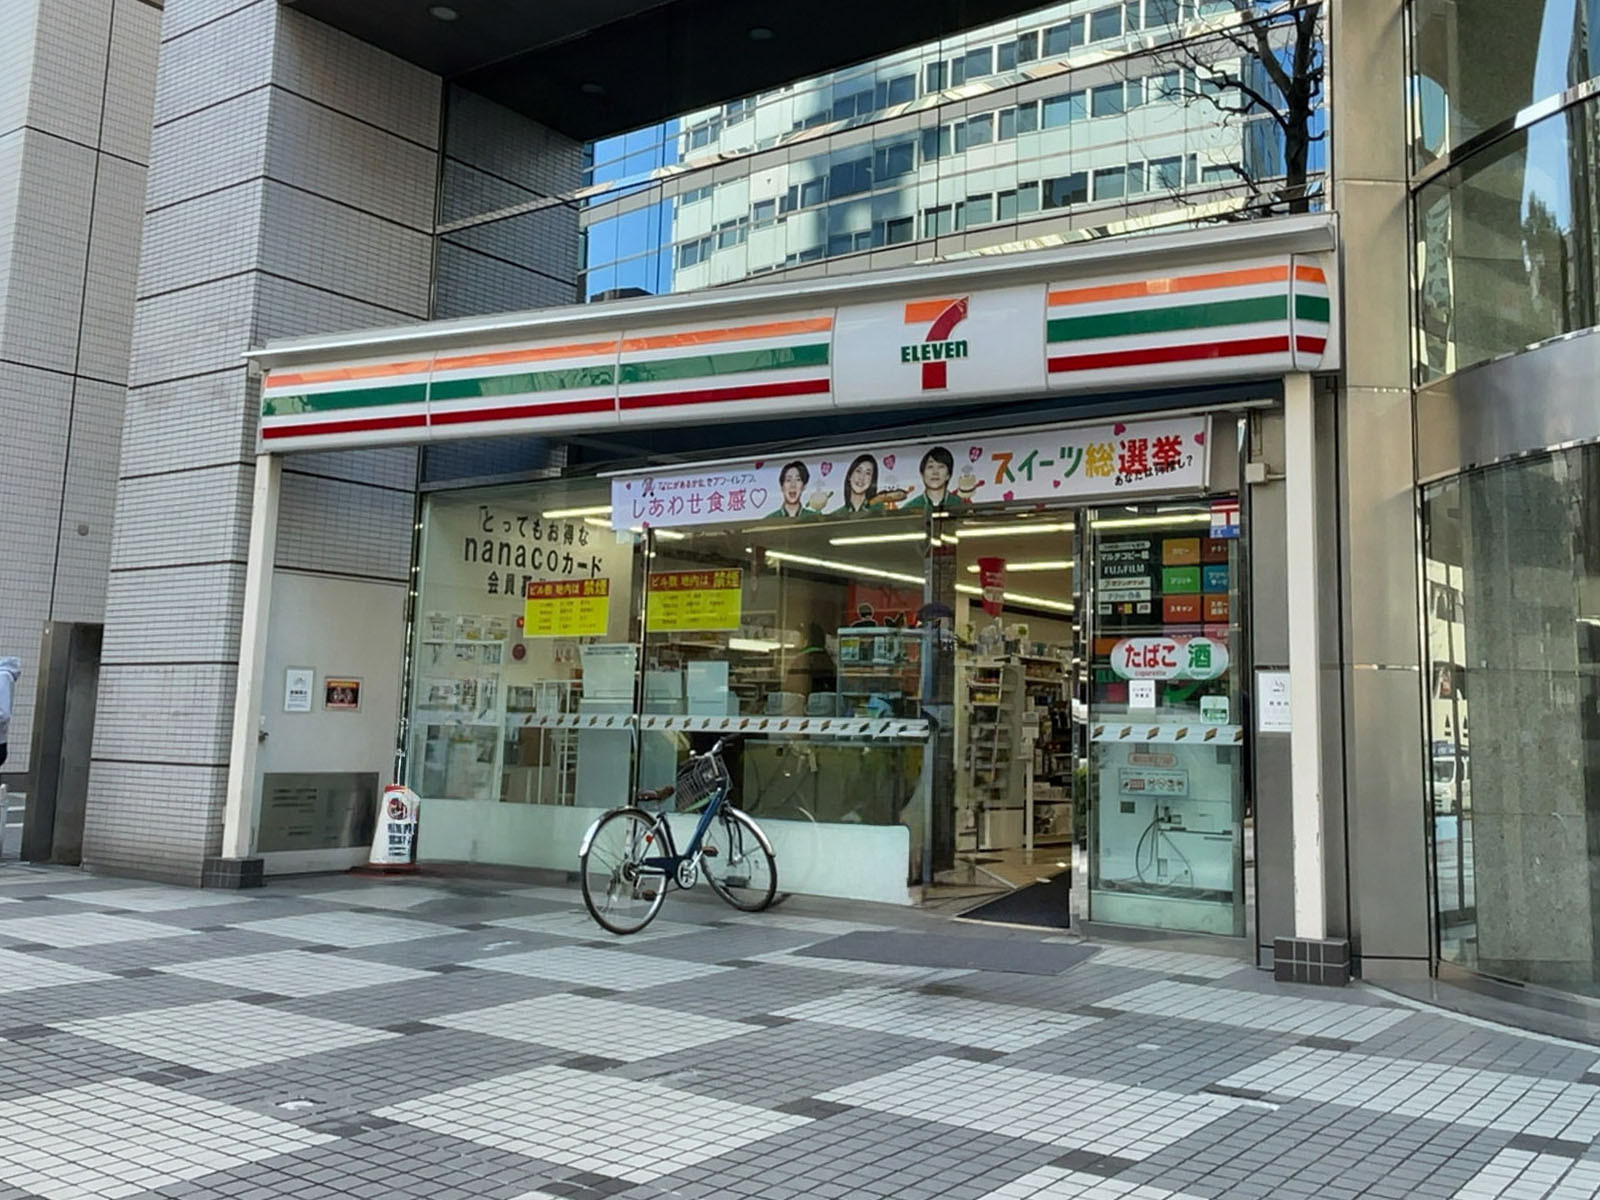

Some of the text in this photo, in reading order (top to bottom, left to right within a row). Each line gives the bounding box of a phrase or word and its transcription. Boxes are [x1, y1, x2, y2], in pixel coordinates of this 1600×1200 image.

[904, 296, 969, 390] 7
[991, 434, 1182, 485] スイーツ総選挙
[464, 537, 602, 578] nanacoカード
[1125, 643, 1212, 668] たばこ 酒
